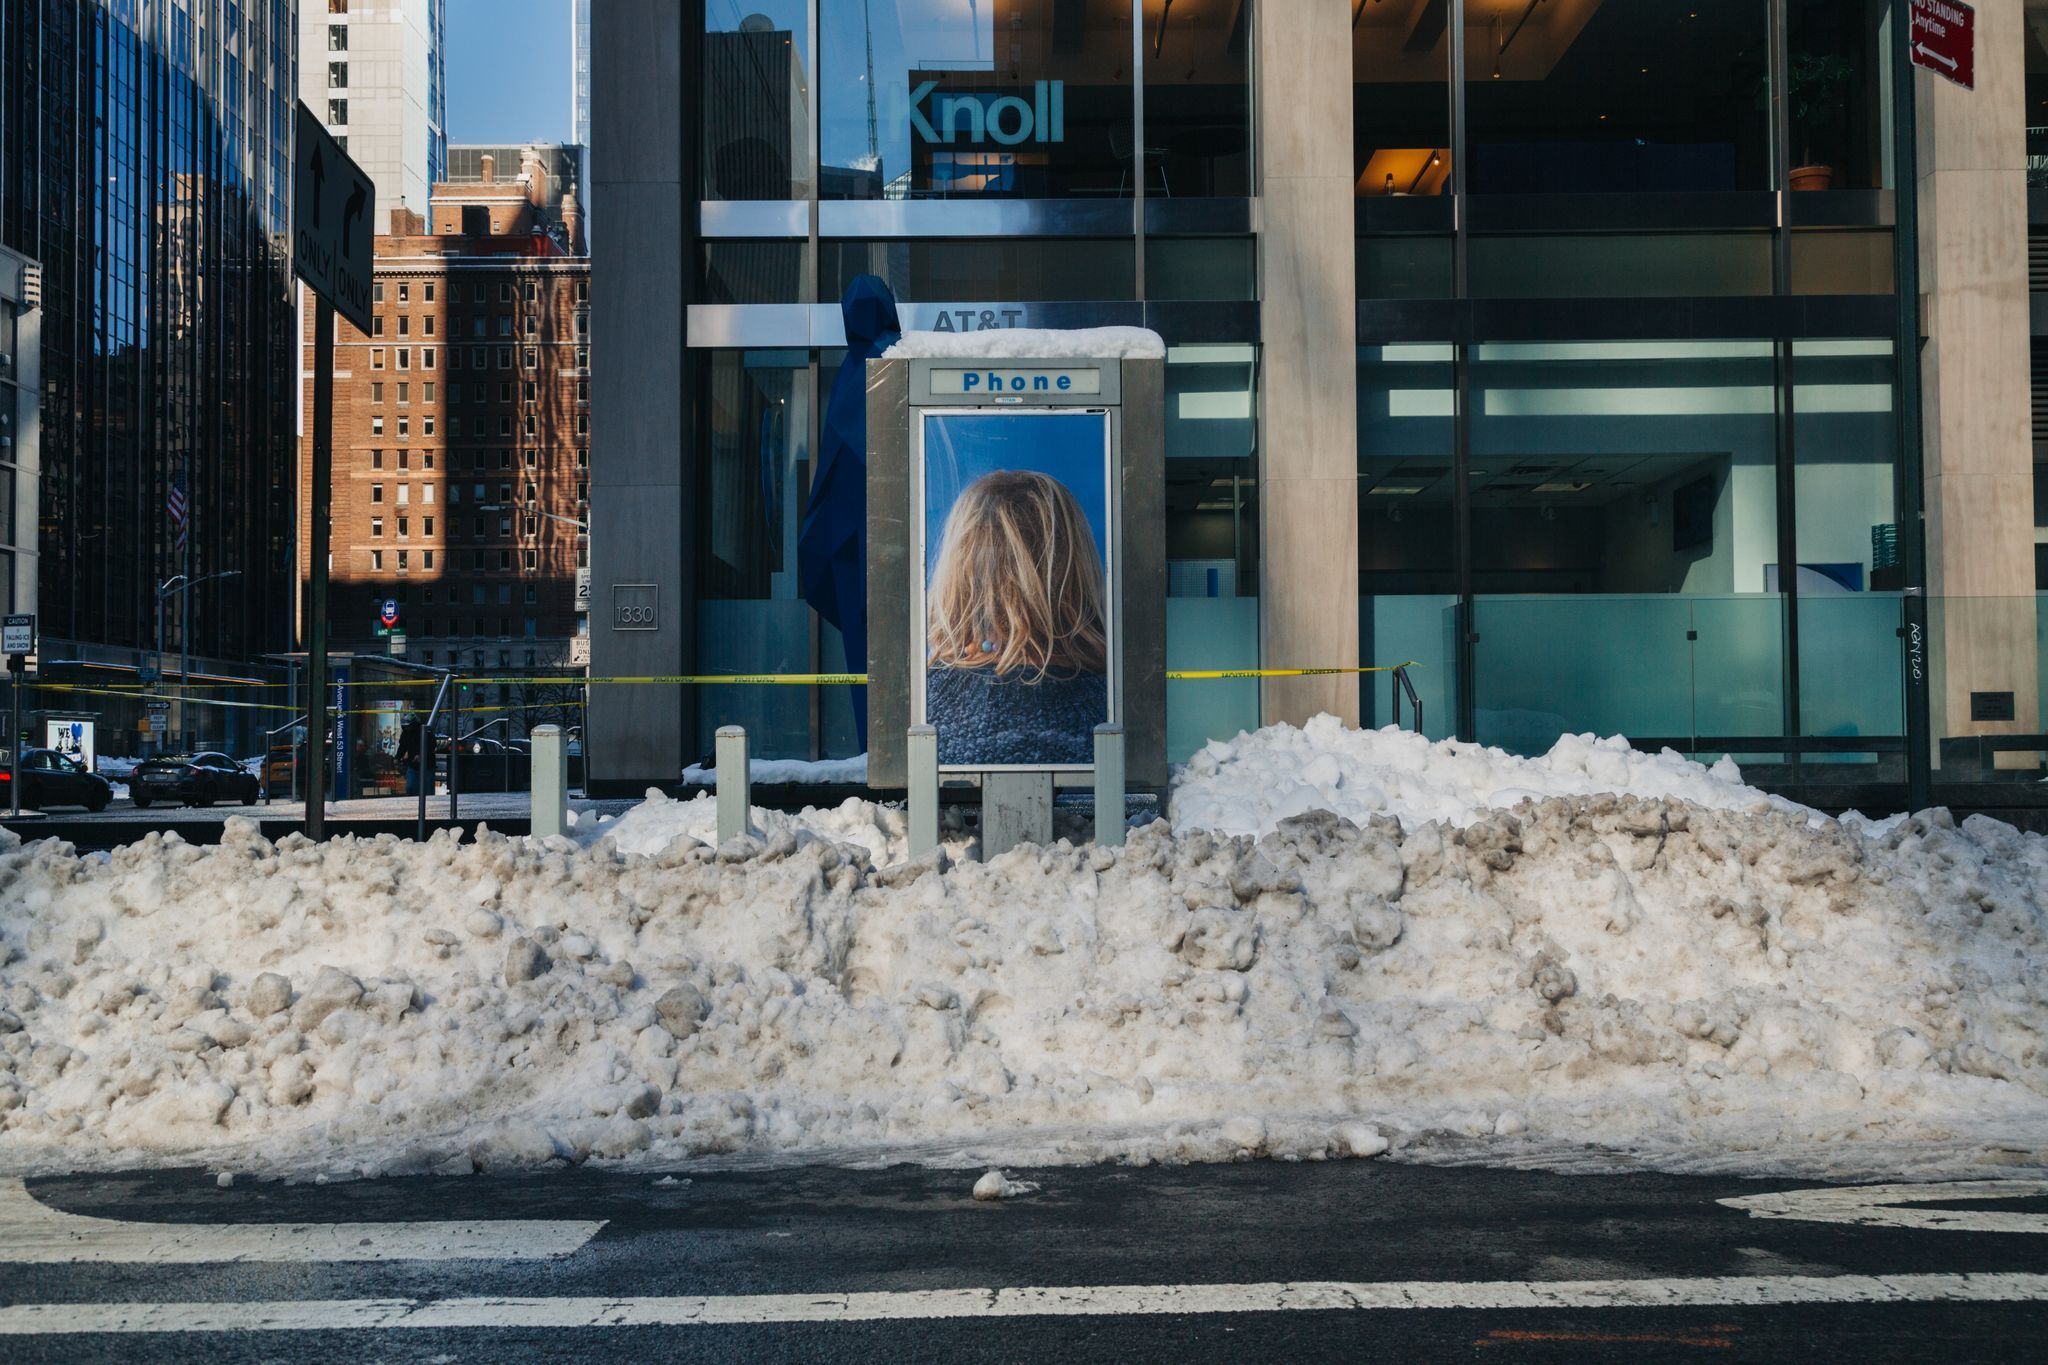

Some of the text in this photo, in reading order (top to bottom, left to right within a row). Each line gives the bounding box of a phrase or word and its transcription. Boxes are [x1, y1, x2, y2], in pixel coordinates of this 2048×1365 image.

[1927, 0, 1965, 27] STANDING
[1915, 11, 1946, 38] Anytime
[889, 79, 1064, 145] Knoll
[300, 229, 331, 281] ONLY
[338, 266, 369, 315] ONLY
[933, 310, 1023, 333] AT&T
[963, 373, 1072, 391] Phone
[579, 585, 591, 597] 2
[8, 617, 29, 625] CAUTION
[616, 606, 654, 623] 1330
[57, 727, 71, 739] WE
[337, 720, 345, 739] West
[337, 740, 345, 750] 53
[337, 751, 345, 773] Street
